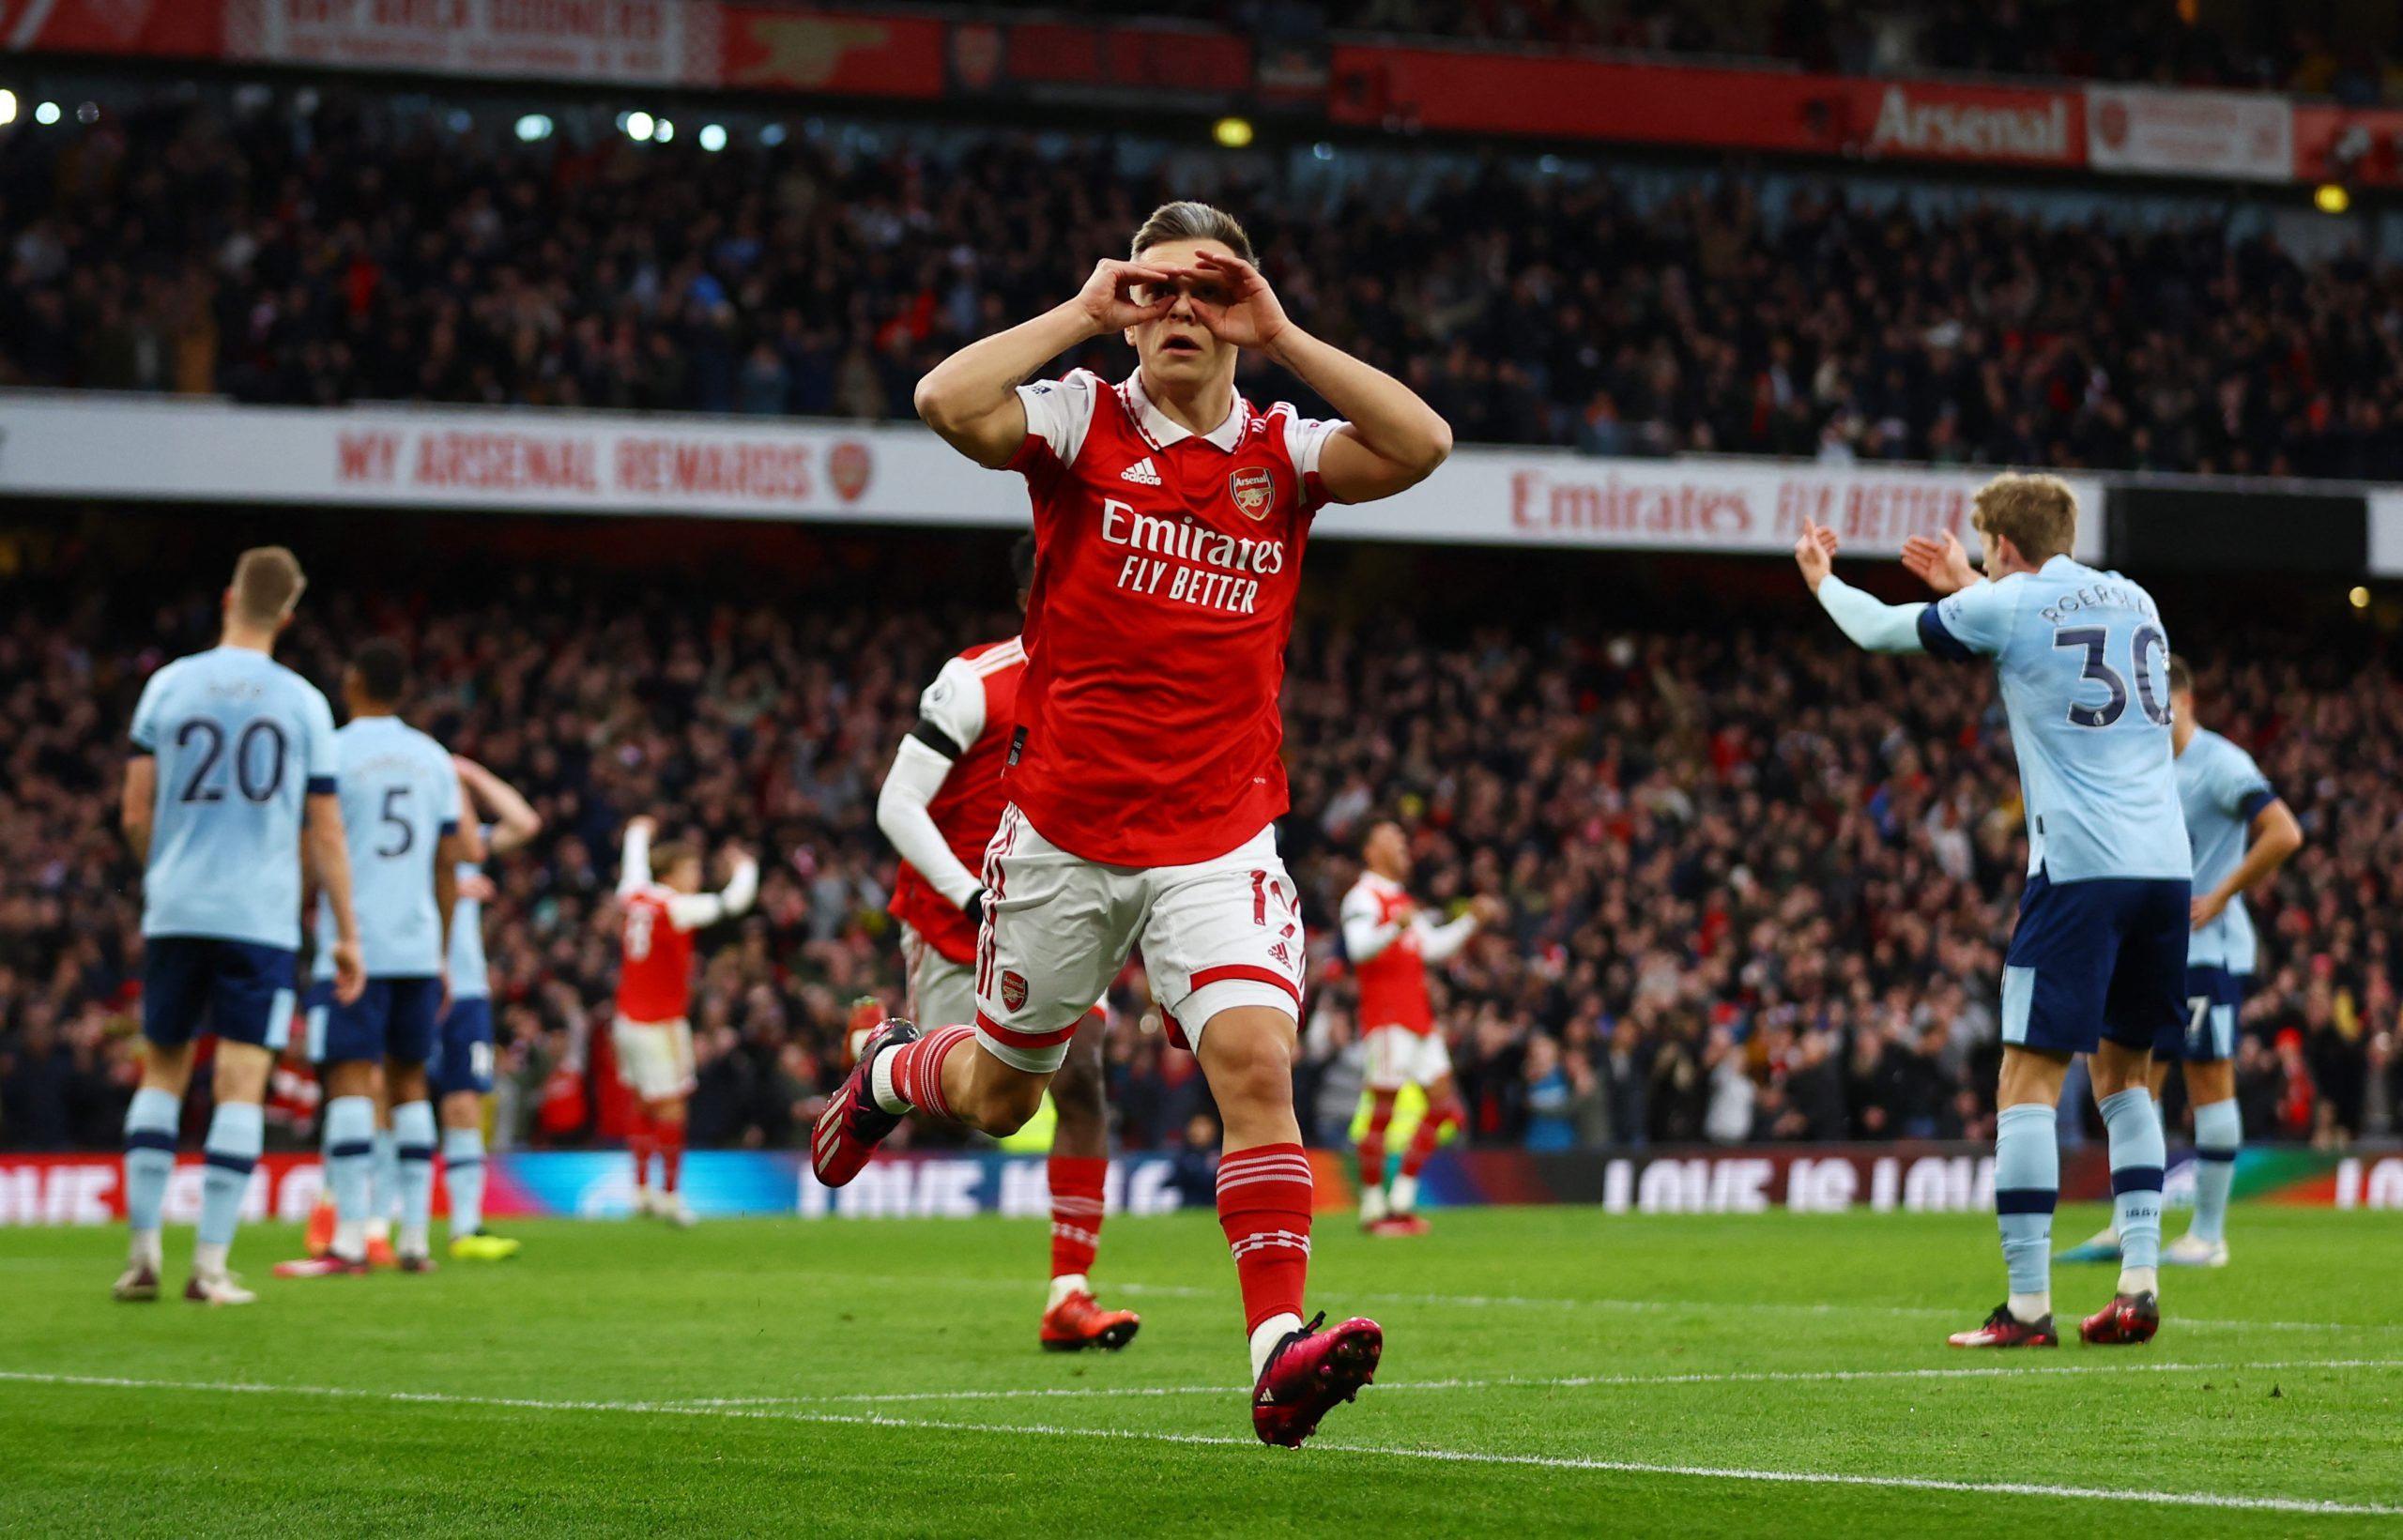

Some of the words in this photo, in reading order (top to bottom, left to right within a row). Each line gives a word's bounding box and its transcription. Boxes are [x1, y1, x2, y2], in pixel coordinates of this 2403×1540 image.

[1872, 84, 2069, 156] Arsenal
[337, 431, 399, 482] MY
[413, 433, 598, 494] ARSENAL
[615, 436, 812, 499] REWARDS
[1120, 470, 1162, 486] adidas
[1234, 474, 1267, 487] Arsenal
[1101, 497, 1283, 575] Emirates
[1510, 470, 1753, 532] Emirates
[1842, 483, 1964, 538] BETTER
[1117, 556, 1168, 595] FLY
[1169, 565, 1259, 615] BETTER
[2052, 624, 2174, 728] 30
[176, 718, 288, 803] 20
[377, 786, 414, 858] 5
[1603, 1158, 1772, 1214] LOVE
